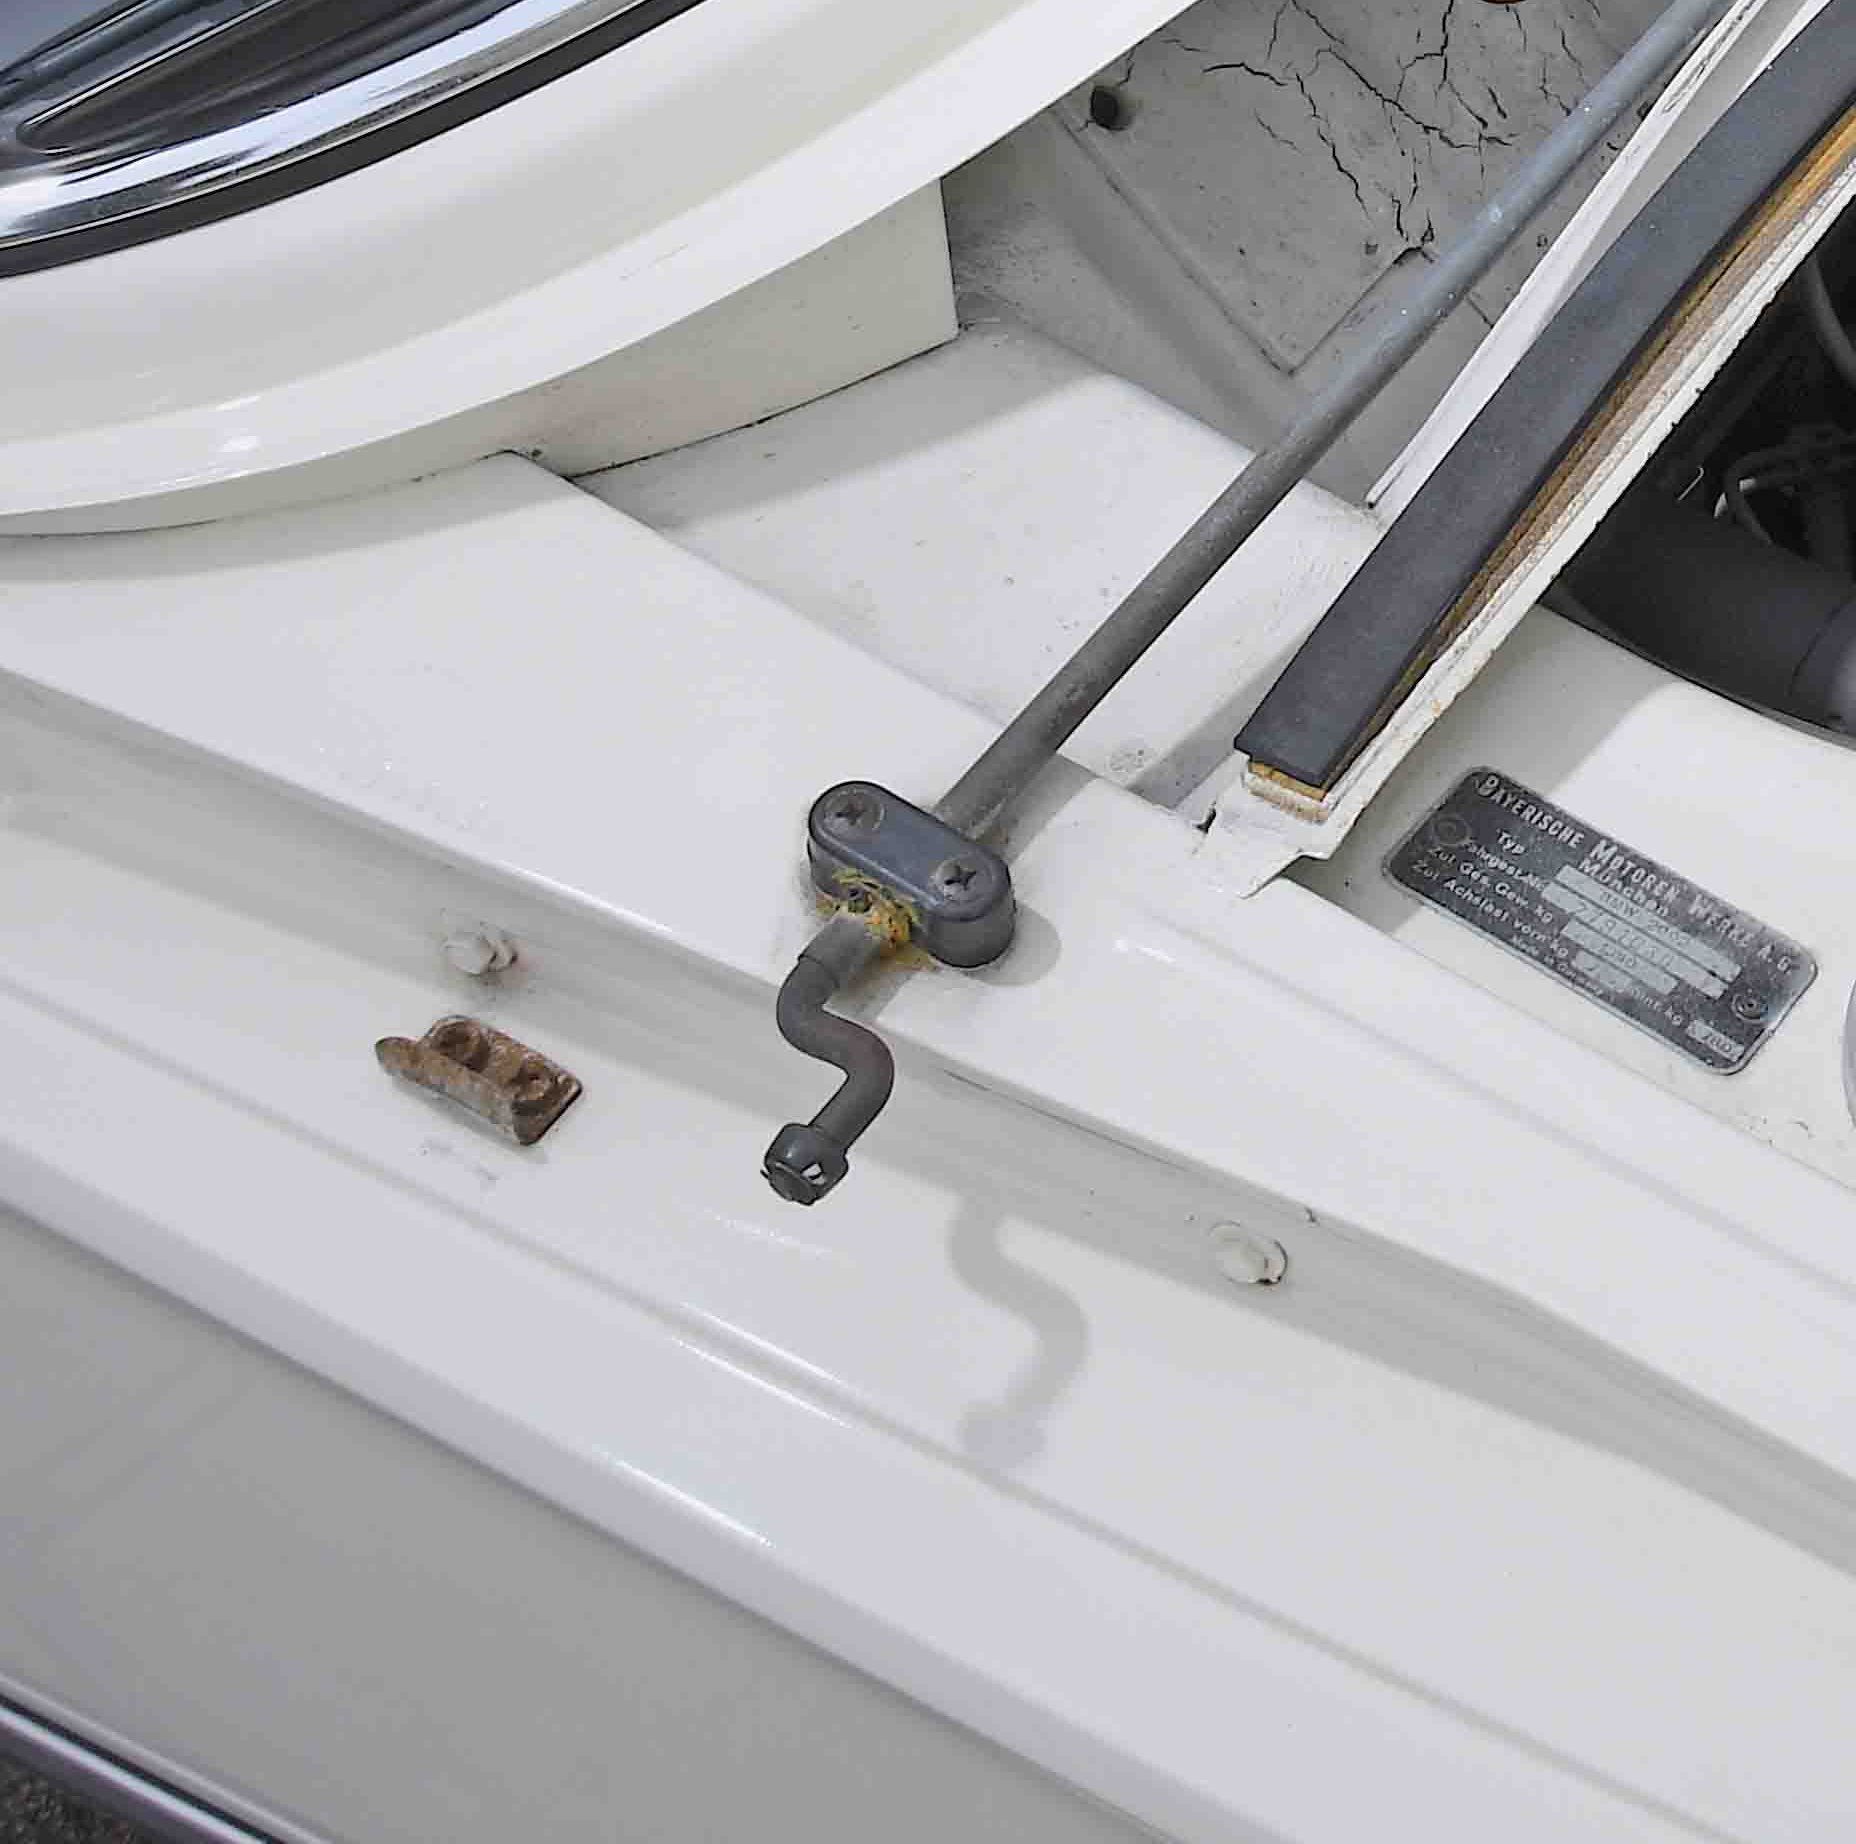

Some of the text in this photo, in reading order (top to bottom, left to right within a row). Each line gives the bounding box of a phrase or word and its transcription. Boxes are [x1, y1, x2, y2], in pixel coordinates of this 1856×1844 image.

[1494, 829, 1527, 859] Typ
[1477, 773, 1587, 849] BAYERISCHE
[1589, 837, 1682, 904] MOTOREN
[1688, 893, 1758, 947] WERKE
[1532, 904, 1554, 924] kg
